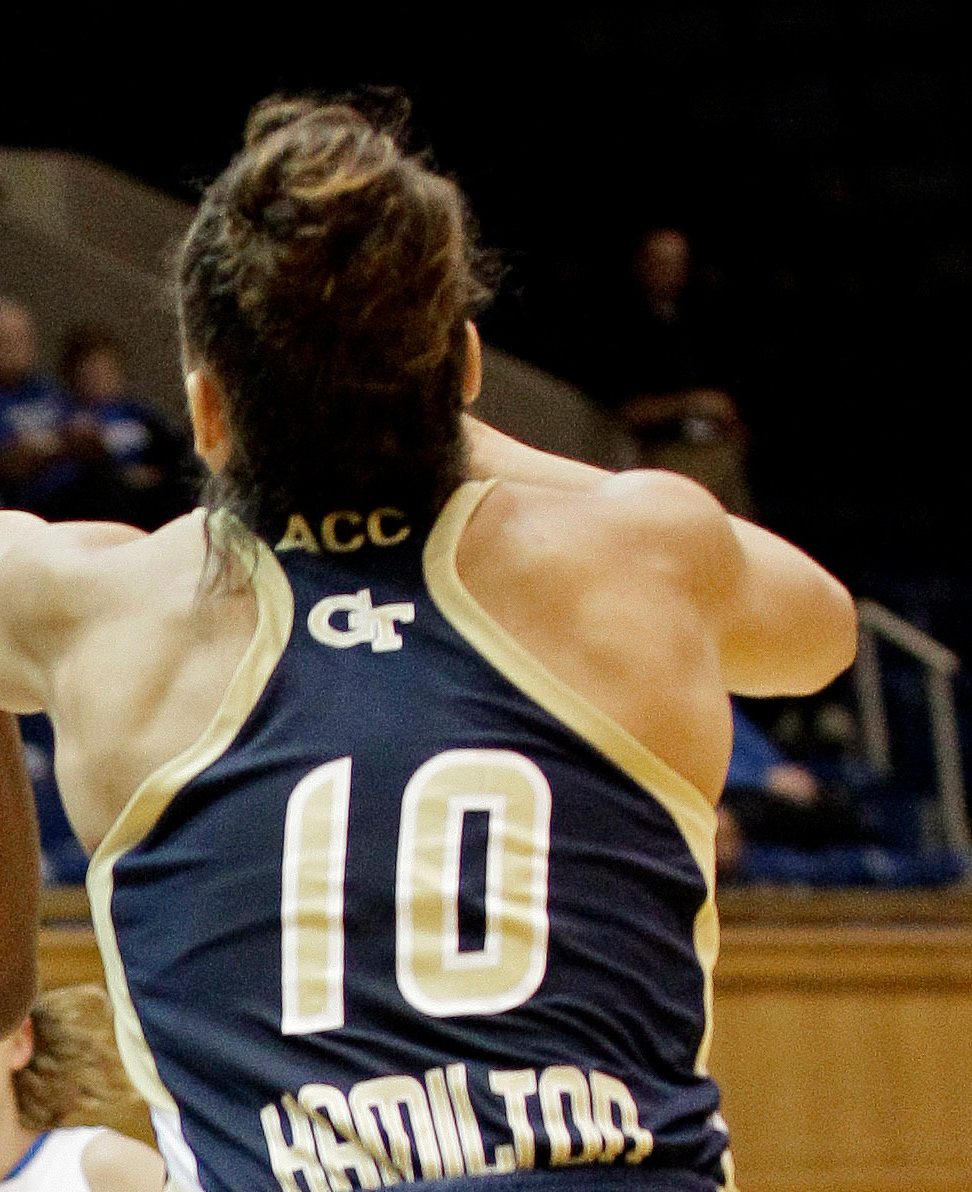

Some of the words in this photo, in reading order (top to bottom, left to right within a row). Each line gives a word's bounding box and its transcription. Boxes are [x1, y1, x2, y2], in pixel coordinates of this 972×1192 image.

[274, 507, 411, 553] ACC
[307, 587, 415, 653] GT
[280, 747, 552, 1036] 10
